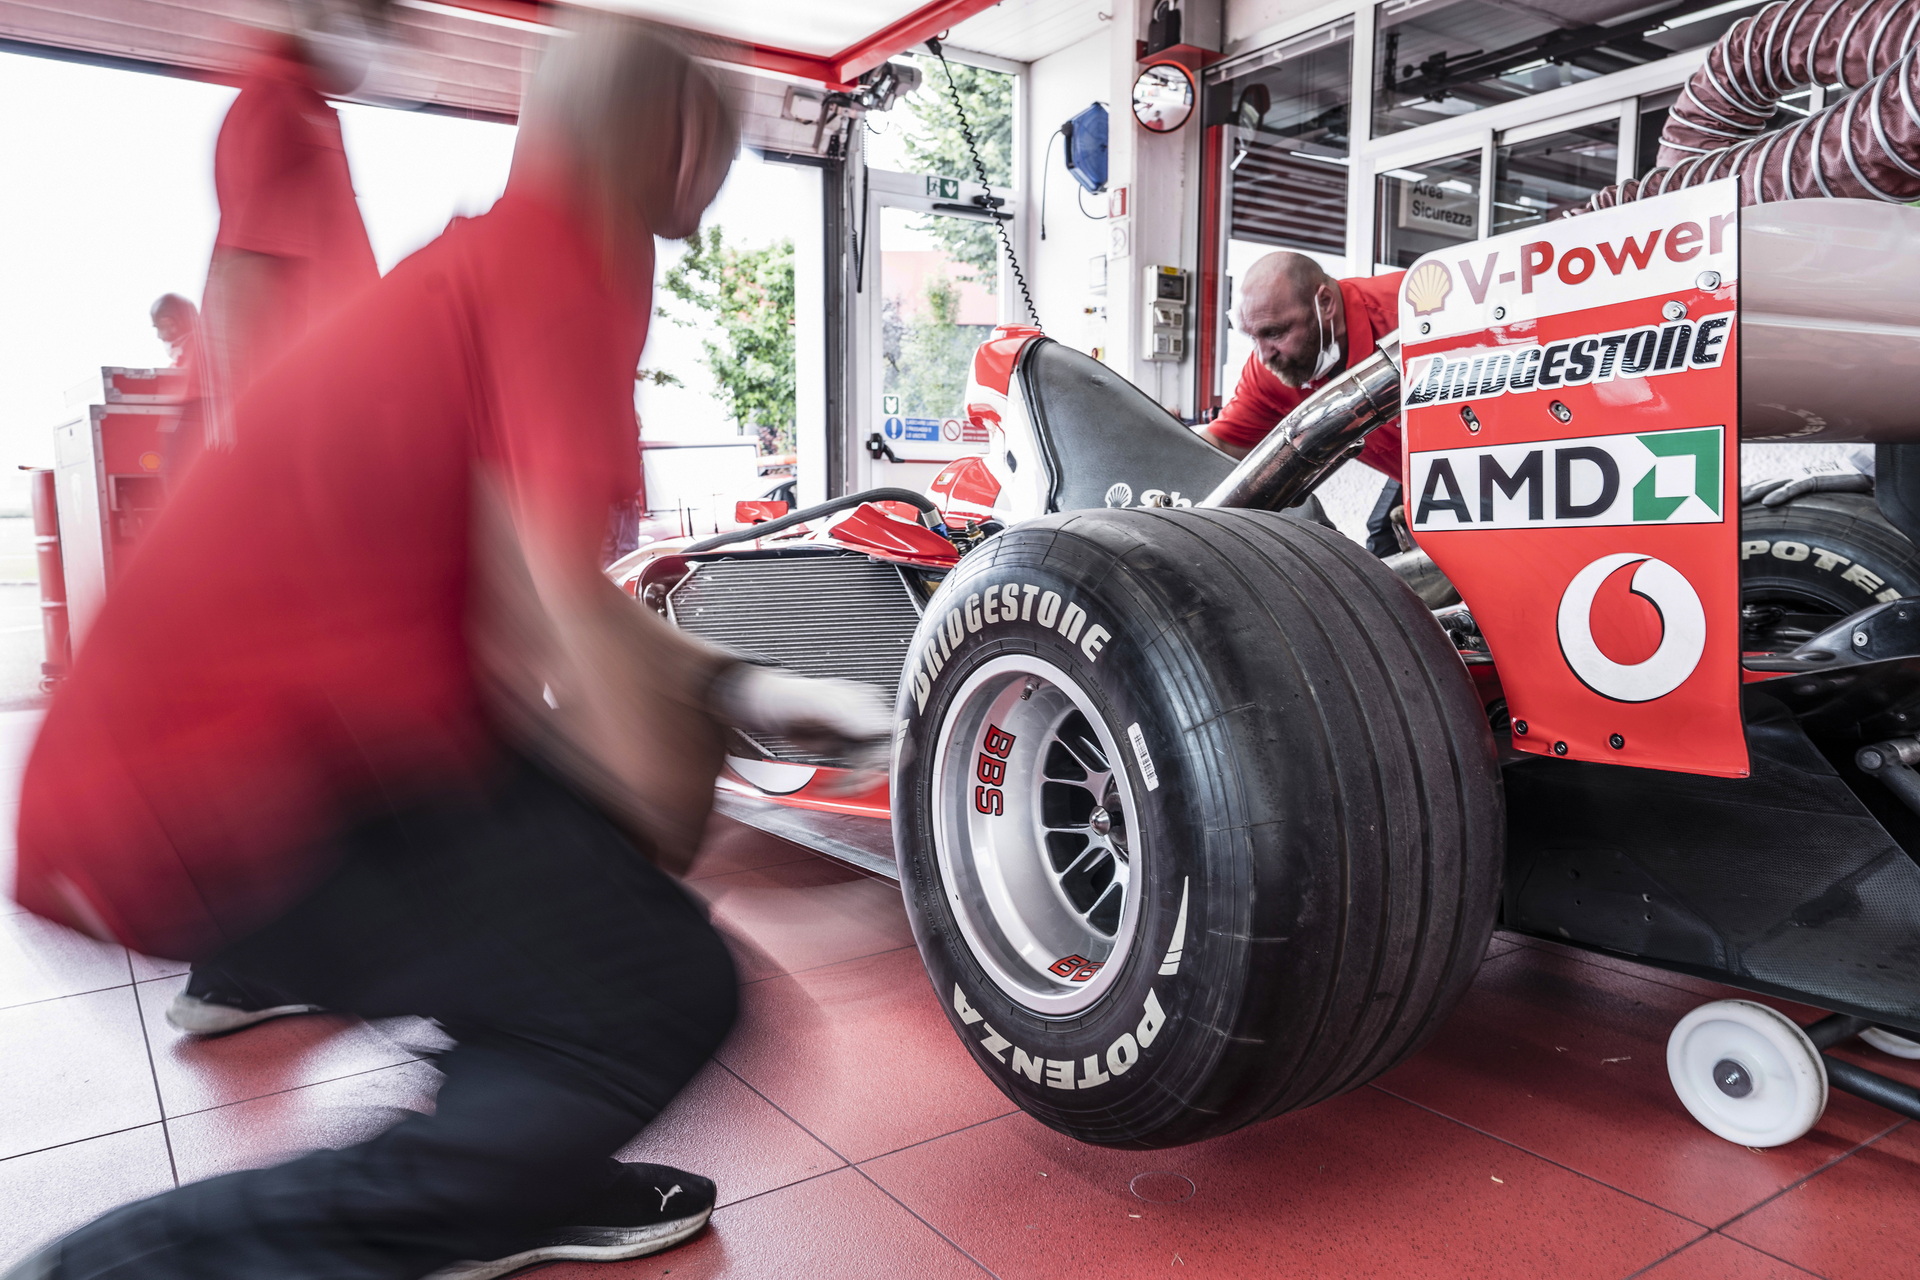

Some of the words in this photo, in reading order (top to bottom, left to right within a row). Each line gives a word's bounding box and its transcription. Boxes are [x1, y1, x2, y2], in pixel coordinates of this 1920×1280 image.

[1412, 199, 1473, 228] Sicurezza
[1413, 181, 1444, 200] Area
[1457, 210, 1737, 305] V-Power
[1404, 314, 1732, 408] BRIDGESTONE
[1414, 446, 1620, 525] AMD
[908, 583, 1112, 716] BRIDGESTONE
[975, 723, 1016, 817] BBS
[1047, 954, 1106, 982] BB
[954, 982, 1166, 1090] POTENZA
